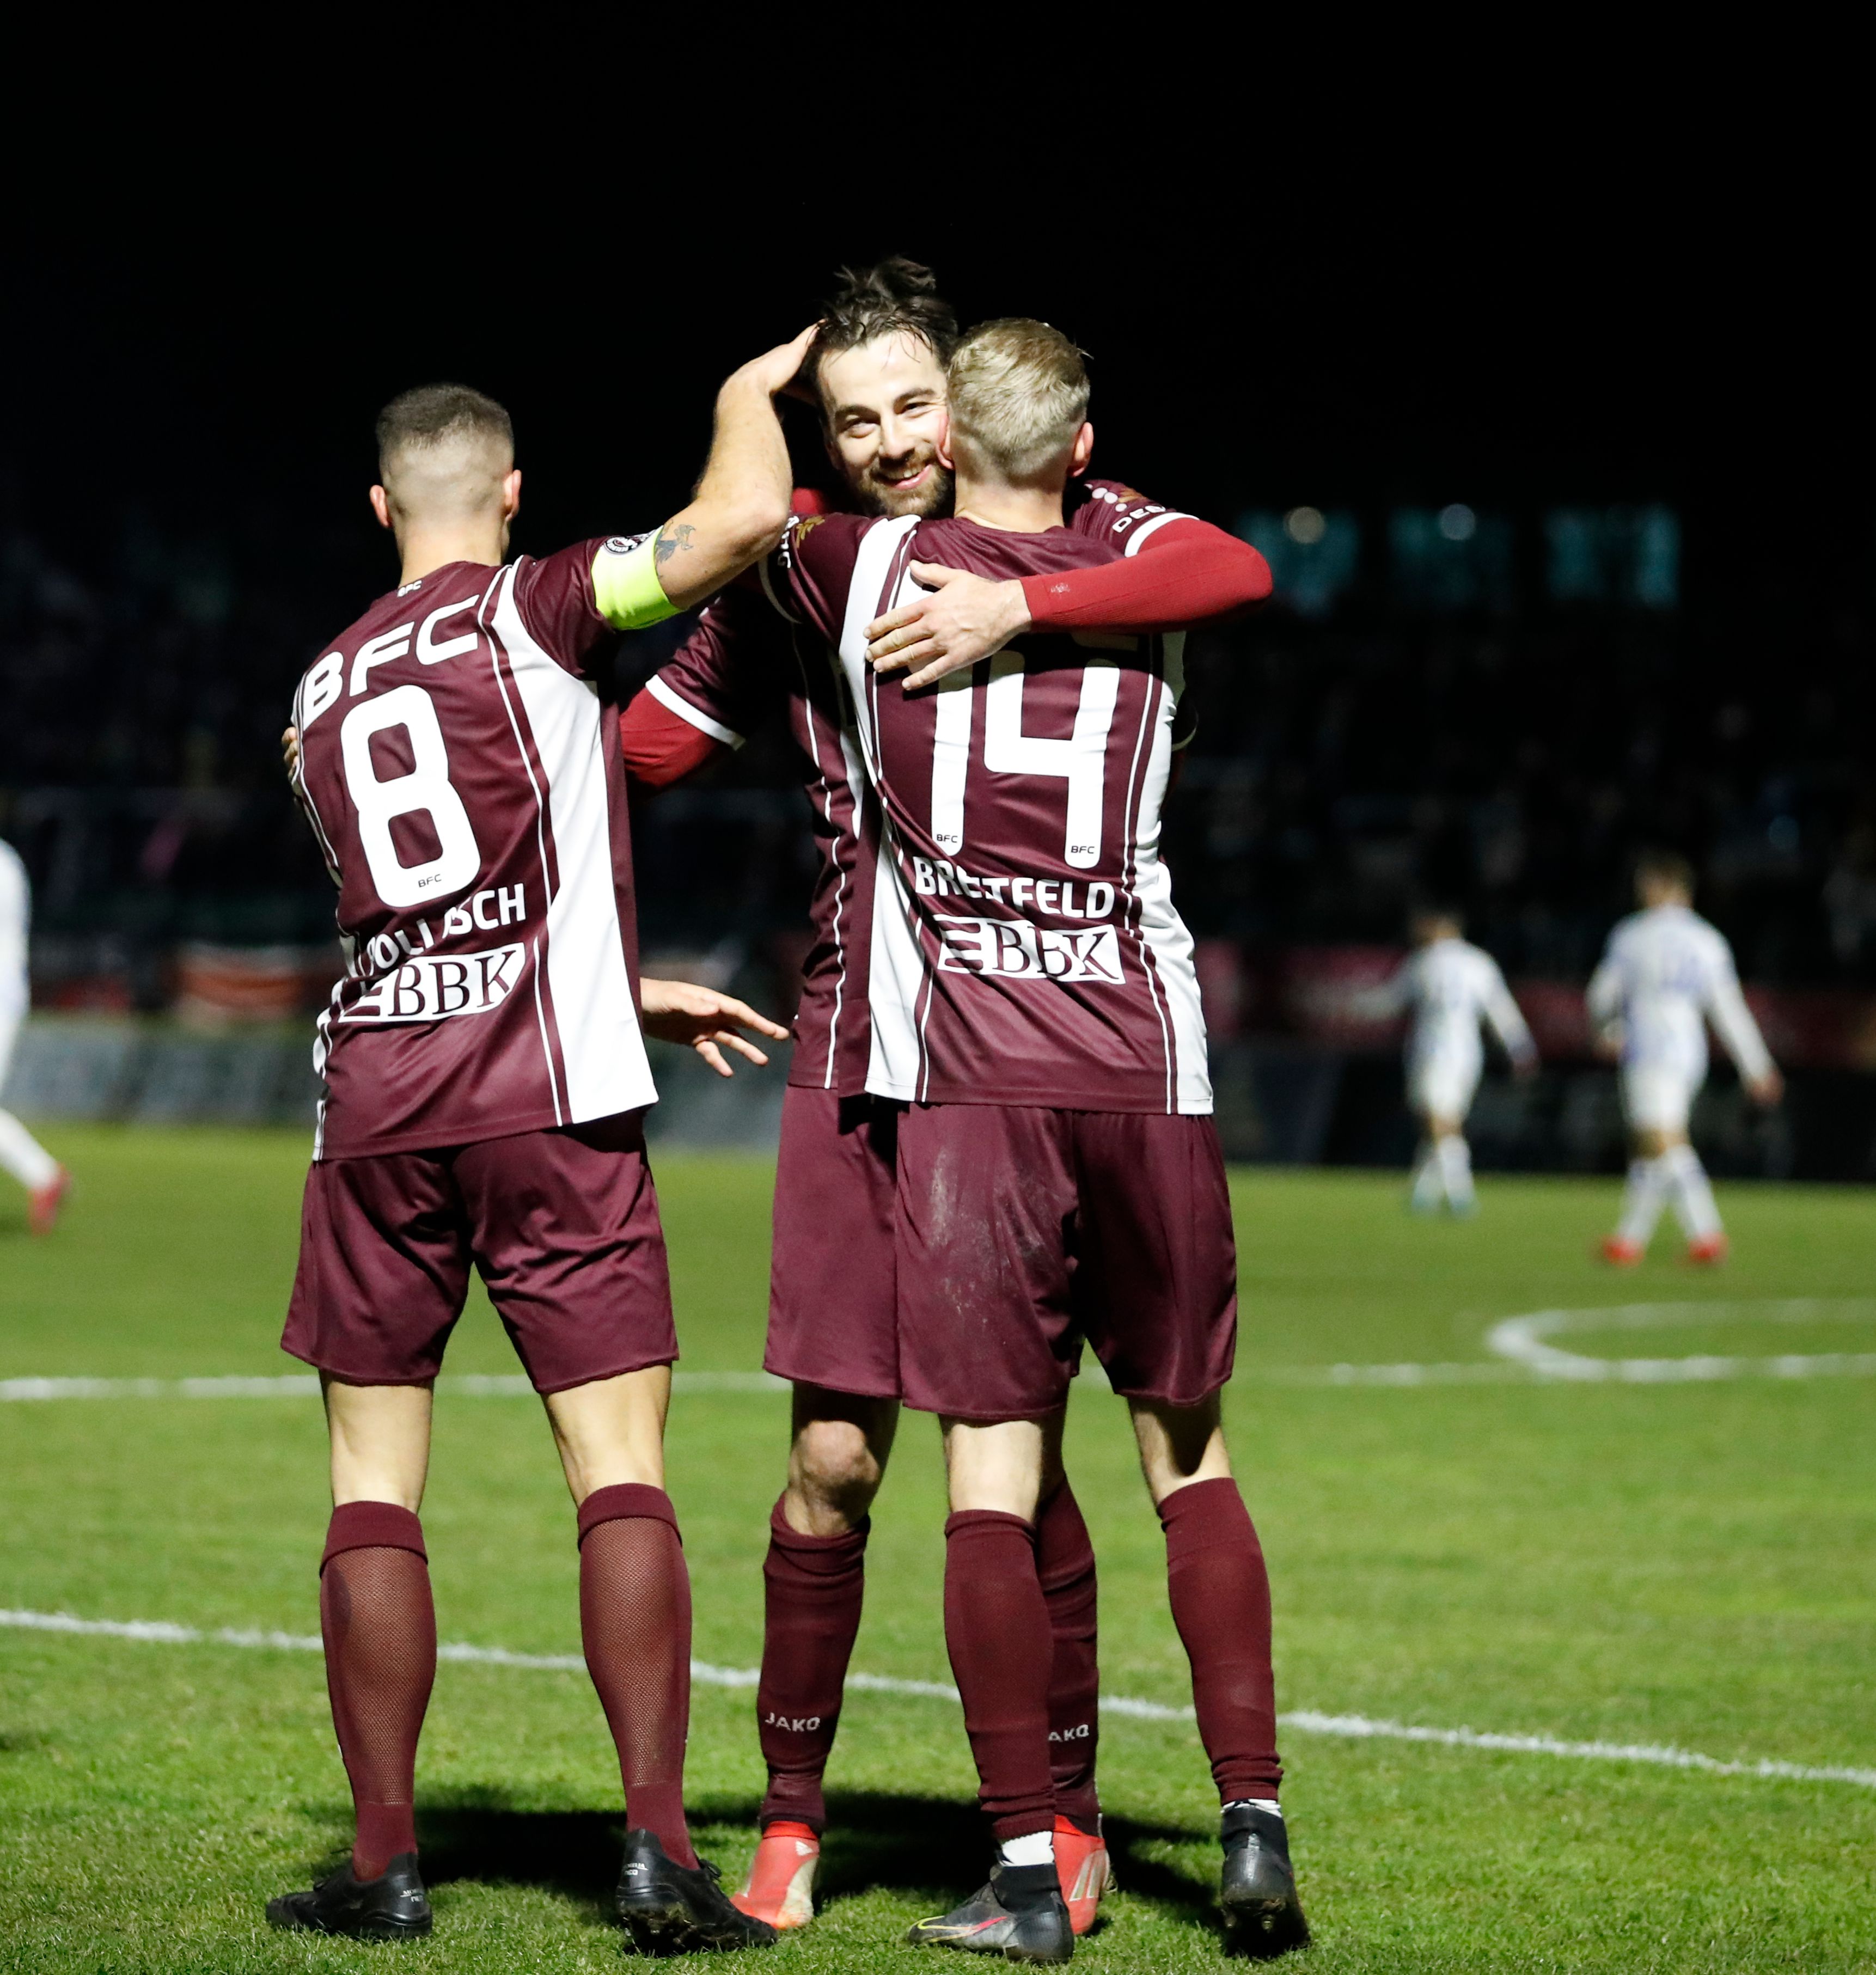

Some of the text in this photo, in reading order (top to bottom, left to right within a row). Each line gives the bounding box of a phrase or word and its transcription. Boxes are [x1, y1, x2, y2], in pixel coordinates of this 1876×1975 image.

[303, 594, 480, 731] BFC
[908, 650, 1121, 869] 14
[340, 684, 481, 908] 8
[936, 834, 958, 843] BFC
[1070, 845, 1095, 855] BFC
[418, 873, 442, 888] BFC
[913, 856, 1115, 919] BRETFELD
[765, 1711, 821, 1732] JAKO
[1048, 1723, 1090, 1742] AKO
